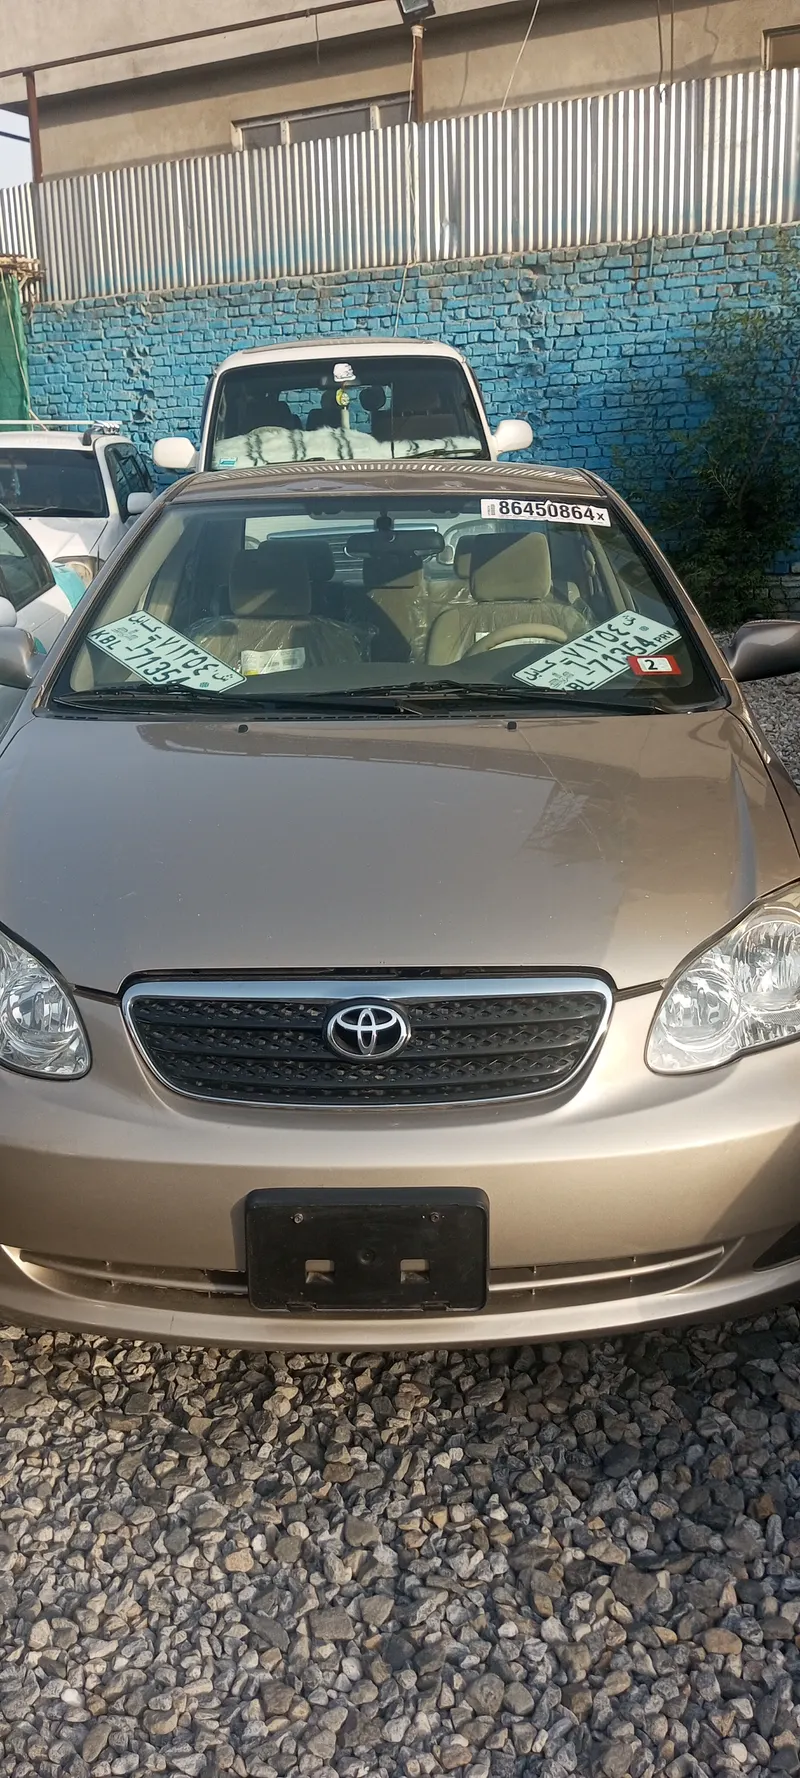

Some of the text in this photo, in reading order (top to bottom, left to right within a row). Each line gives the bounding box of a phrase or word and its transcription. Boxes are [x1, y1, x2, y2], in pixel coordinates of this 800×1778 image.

[91, 629, 122, 650] KBL
[653, 630, 675, 644] PRV
[644, 659, 658, 670] 2
